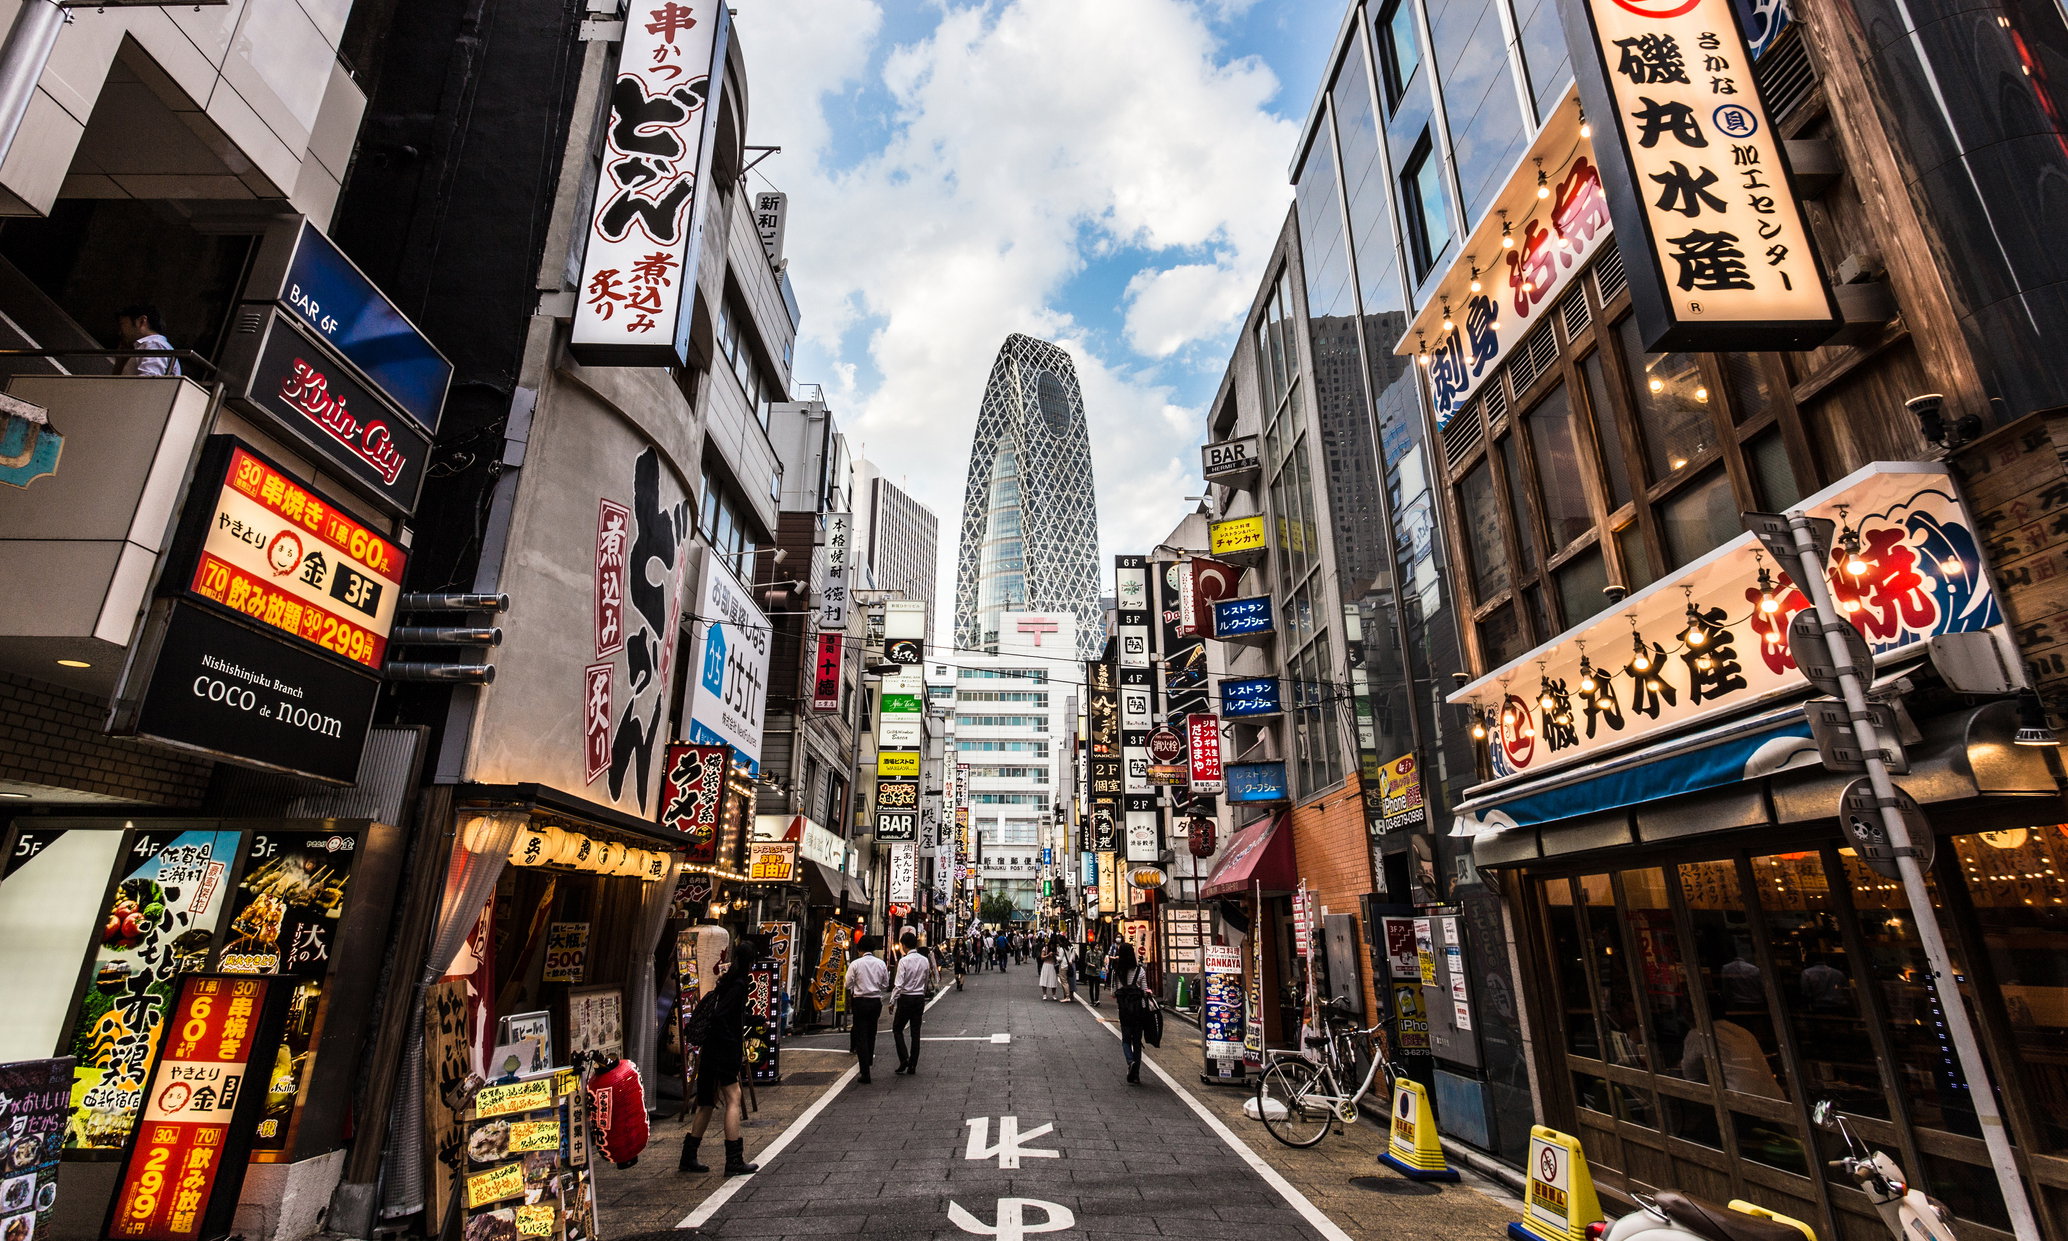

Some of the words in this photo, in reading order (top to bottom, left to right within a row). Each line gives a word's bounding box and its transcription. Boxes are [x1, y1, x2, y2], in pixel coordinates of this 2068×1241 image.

[645, 2, 698, 81] 串かつ
[1612, 32, 1756, 292] 磯丸水産
[587, 269, 628, 321] 炙り
[624, 252, 679, 333] 煮込み
[290, 284, 320, 322] BAR
[321, 315, 338, 335] 6F
[281, 357, 407, 485] Kirin-City
[1210, 444, 1246, 465] BAR
[1211, 463, 1236, 472] HERMIT
[239, 459, 260, 486] 30
[261, 473, 323, 531] 串焼き
[219, 512, 267, 549] やきとり
[330, 521, 348, 544] 1串
[350, 529, 384, 568] 60
[1216, 533, 1261, 547] チャンカヤ
[830, 518, 847, 579] 本格焼酎
[206, 563, 228, 591] 70
[299, 551, 327, 590] 金
[1123, 559, 1138, 567] 6F
[345, 575, 374, 608] 3F
[598, 517, 626, 647] 煮込み
[226, 575, 304, 635] 飲み放題
[712, 577, 766, 656] お部屋探しなら
[1222, 604, 1264, 616] レストラン
[303, 609, 321, 630] 30
[318, 617, 364, 660] 299
[201, 654, 271, 687] Nishishinjuku
[273, 679, 304, 699] Branch
[1127, 675, 1143, 683] 4F
[1228, 684, 1271, 696] レストラン
[1536, 607, 1748, 753] 磯丸水産
[259, 705, 271, 718] de
[276, 701, 342, 738] noom
[585, 677, 611, 763] 炙り
[1130, 736, 1146, 744] 3F
[1153, 740, 1178, 752] 消火栓
[1192, 724, 1204, 772] だるまや
[1202, 720, 1213, 776] ジンギスカン
[1096, 764, 1118, 775] 2F
[699, 753, 722, 823] 横浜家系
[1094, 780, 1121, 792] 個室
[1133, 801, 1148, 809] 2F
[1383, 796, 1407, 816] iPhone
[880, 816, 912, 831] BAR
[16, 834, 43, 856] 5F
[133, 835, 160, 857] 4F
[159, 844, 212, 867] 佐賀県
[251, 836, 278, 857] 3F
[157, 868, 203, 884] 三瀬村
[752, 863, 792, 879] 自由!!
[892, 856, 902, 894] チャーハン
[547, 951, 583, 967] 500
[1205, 947, 1240, 955] トルコ料理
[199, 980, 218, 993] 1串
[234, 981, 252, 995] 30
[182, 997, 213, 1042] 60
[218, 997, 253, 1060] 串焼き
[1400, 1019, 1428, 1031] iPho
[171, 1066, 221, 1081] やきとり
[84, 1088, 141, 1108] 西新宿店
[190, 1085, 217, 1112] 金
[224, 1078, 236, 1106] 3F
[196, 1129, 213, 1144] 70
[573, 1110, 583, 1153] 営業中
[131, 1147, 170, 1219] 299
[170, 1147, 215, 1233] 飲み放題
